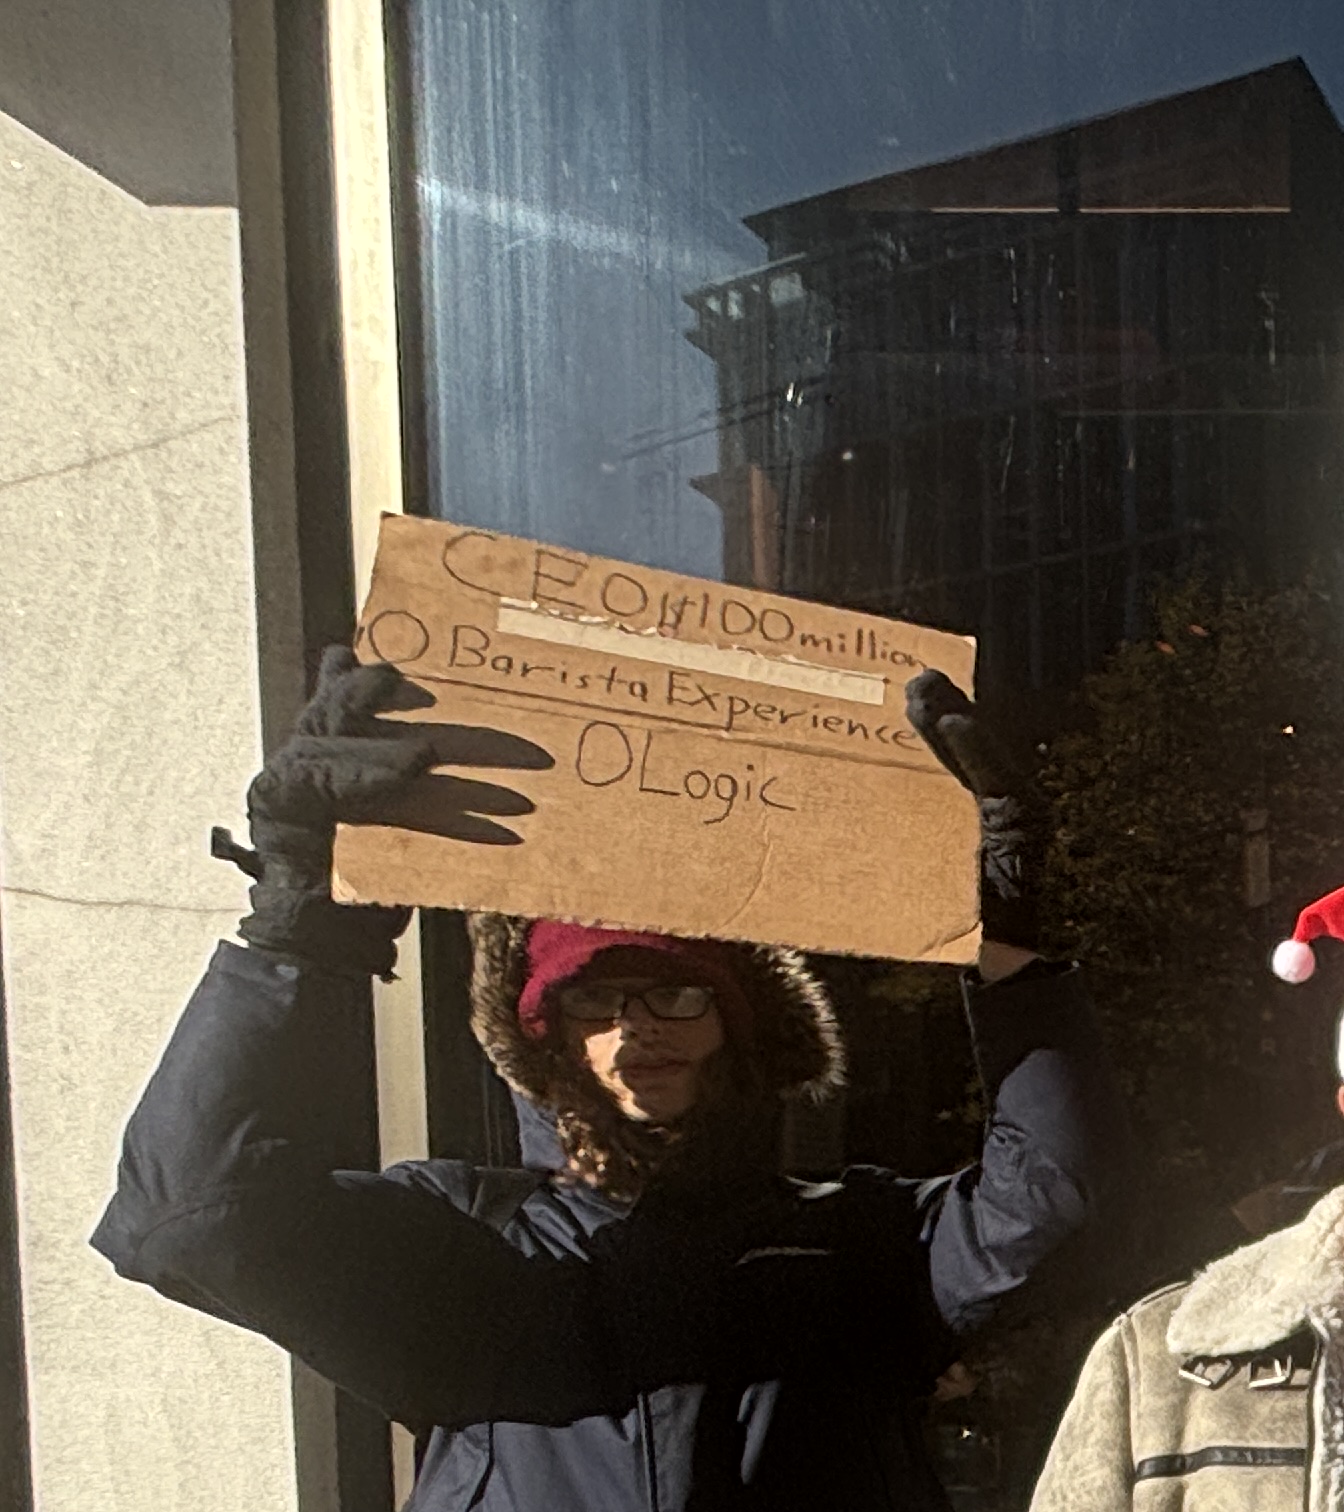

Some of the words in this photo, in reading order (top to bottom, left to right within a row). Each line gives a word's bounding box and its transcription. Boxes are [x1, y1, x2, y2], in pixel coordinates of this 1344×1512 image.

[442, 531, 648, 617] CEO
[449, 624, 649, 703] Barista
[666, 671, 923, 751] Experience
[638, 729, 796, 824] Logic
